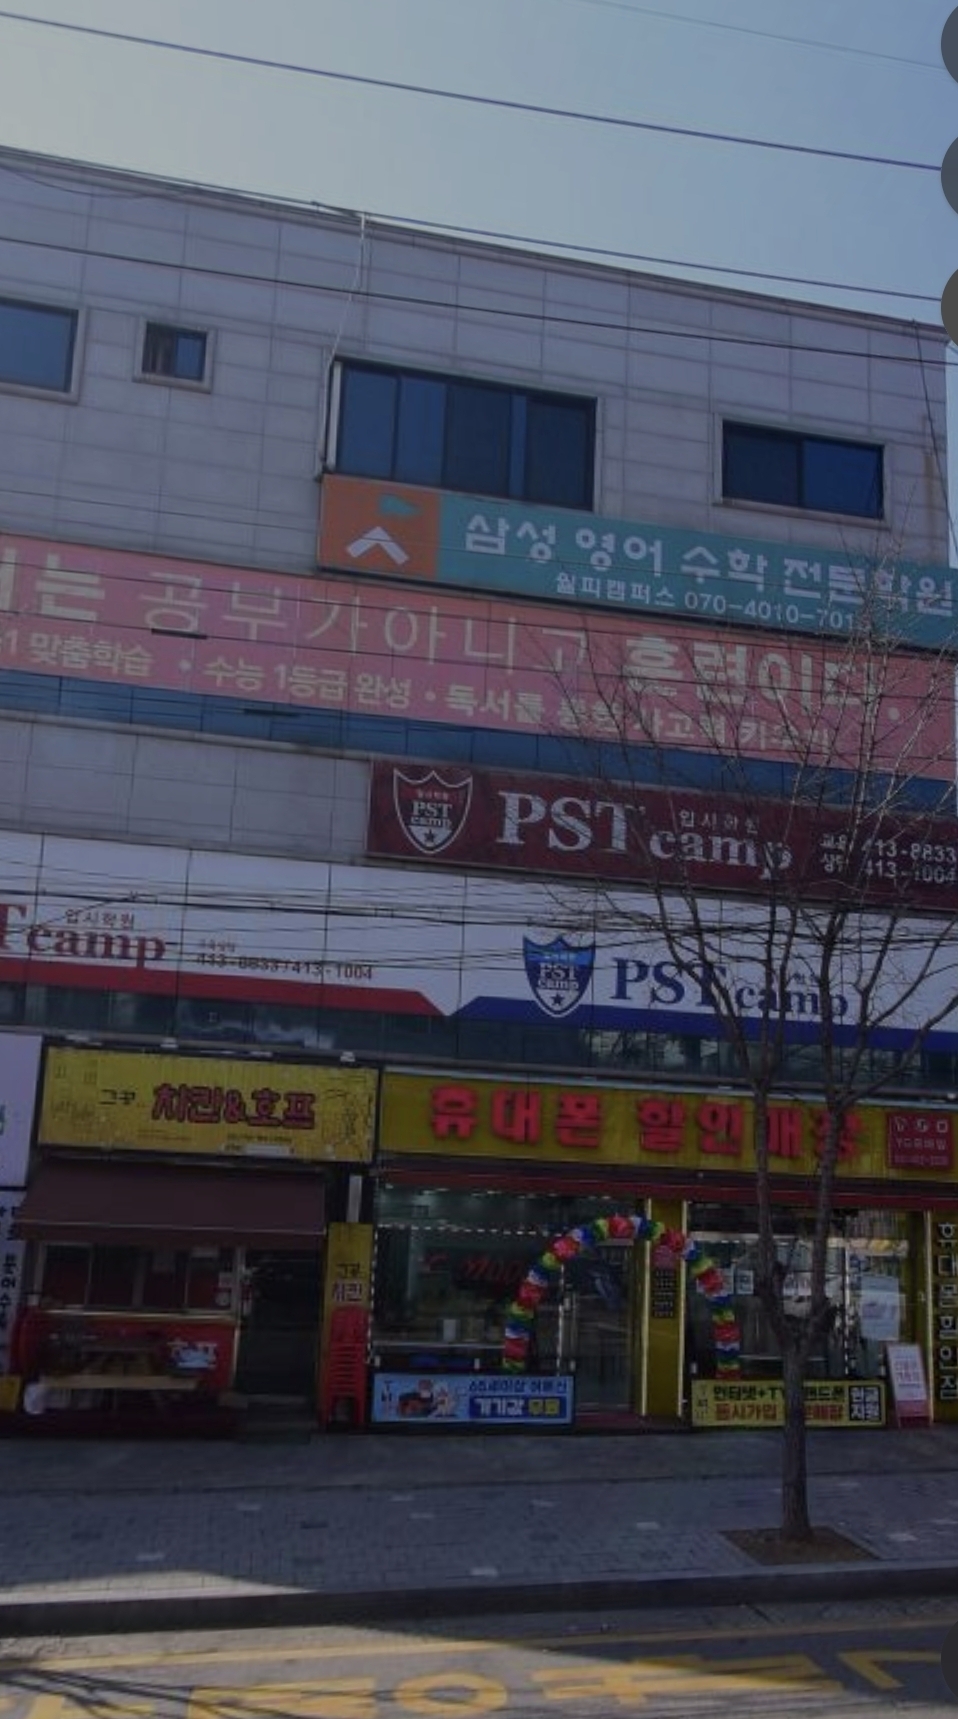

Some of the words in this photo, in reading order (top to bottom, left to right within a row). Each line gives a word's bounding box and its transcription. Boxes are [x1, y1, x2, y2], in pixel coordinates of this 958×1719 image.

[464, 512, 557, 565] 삼성
[575, 531, 663, 577] 영어
[681, 546, 769, 593] 수학
[28, 631, 153, 677] 맞춤학습
[203, 656, 266, 691] 수능
[273, 663, 348, 701] 1등급
[355, 672, 413, 709] 완성
[412, 801, 453, 818] PST
[496, 790, 646, 854] PST
[650, 829, 793, 881] camp
[27, 928, 166, 967] camp
[540, 963, 577, 981] PST
[610, 957, 727, 1007] PST
[152, 1083, 315, 1130] 치킨&호프
[429, 1082, 602, 1149] 휴대폰
